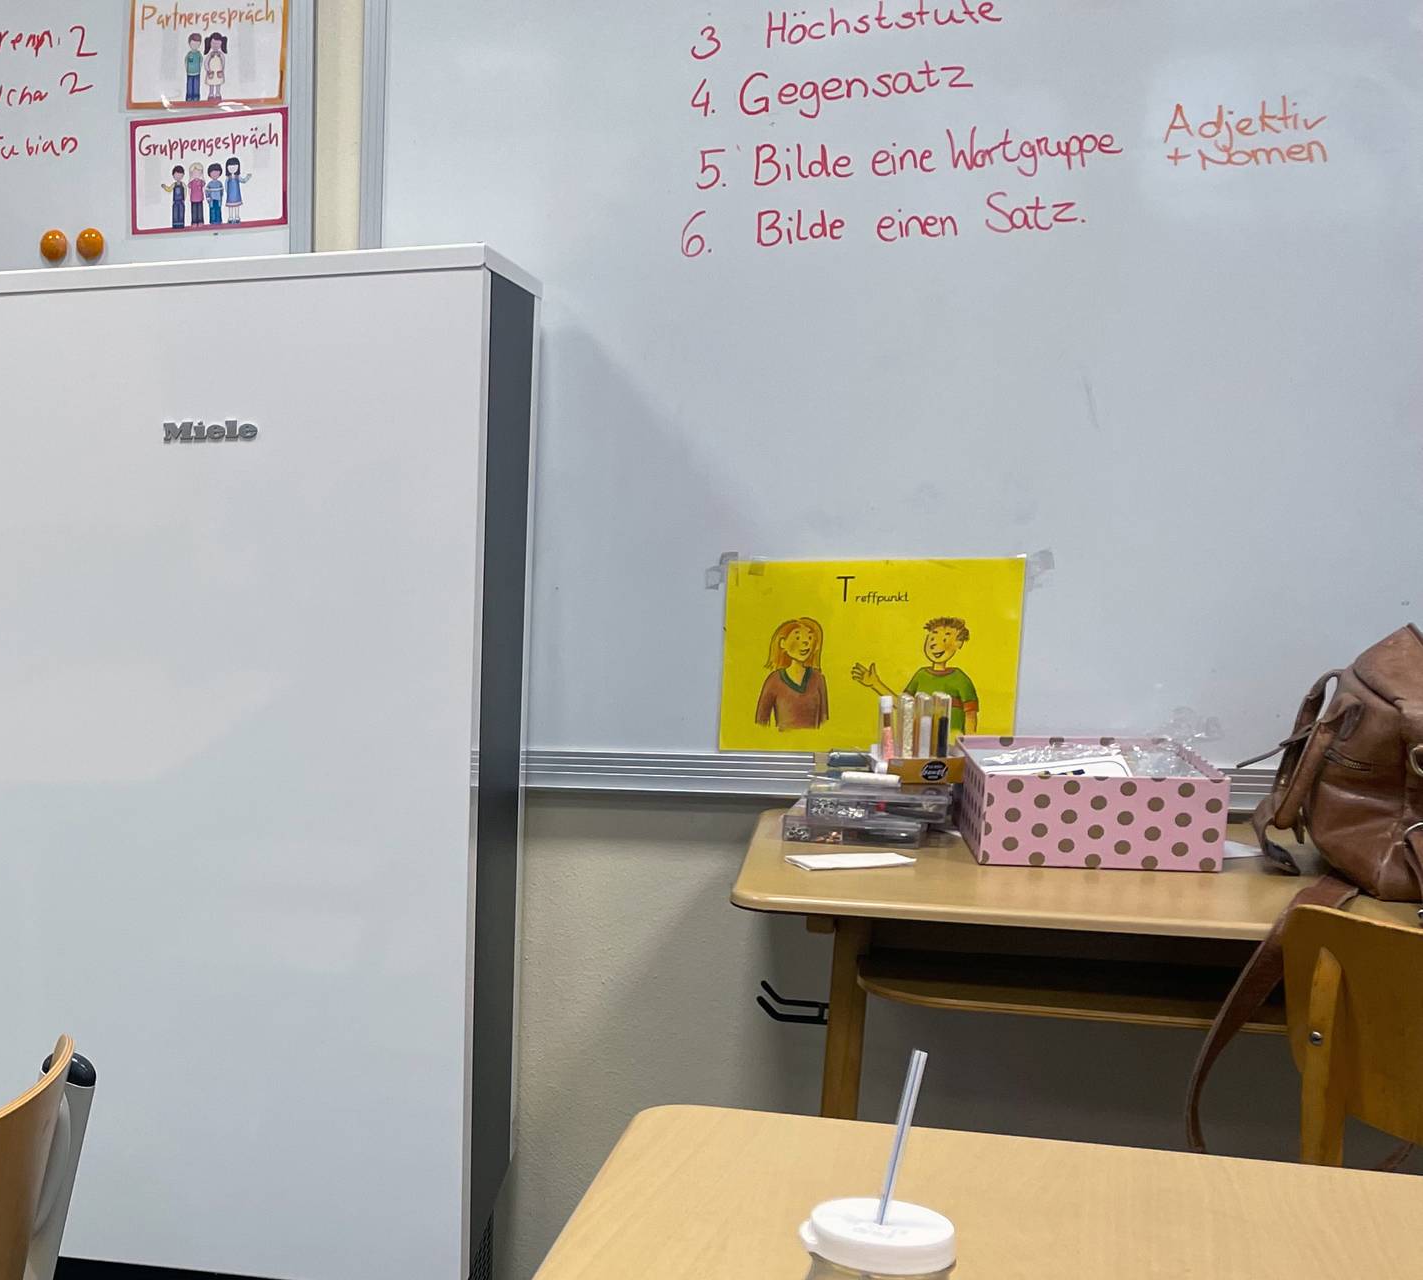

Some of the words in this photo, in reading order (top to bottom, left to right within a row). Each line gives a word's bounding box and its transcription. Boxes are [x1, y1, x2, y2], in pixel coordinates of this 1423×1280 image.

[139, 0, 275, 32] Partnergespräch
[70, 24, 98, 58] 2
[60, 71, 94, 96] 2
[690, 78, 717, 117] 4.
[737, 60, 974, 120] Gegensatz
[1163, 94, 1328, 153] Adjektiv
[137, 122, 280, 160] Gruppengespräch
[696, 147, 728, 190] 5.
[752, 142, 854, 187] Bilde
[870, 142, 937, 178] eine
[946, 126, 1124, 178] Wortgruppe
[1197, 140, 1328, 172] Nomen
[680, 209, 713, 258] 6.
[755, 208, 847, 248] Bilde
[876, 208, 959, 243] einen
[985, 191, 1088, 234] Satz.
[163, 420, 258, 444] Miele
[836, 575, 910, 606] Treffpunkt
